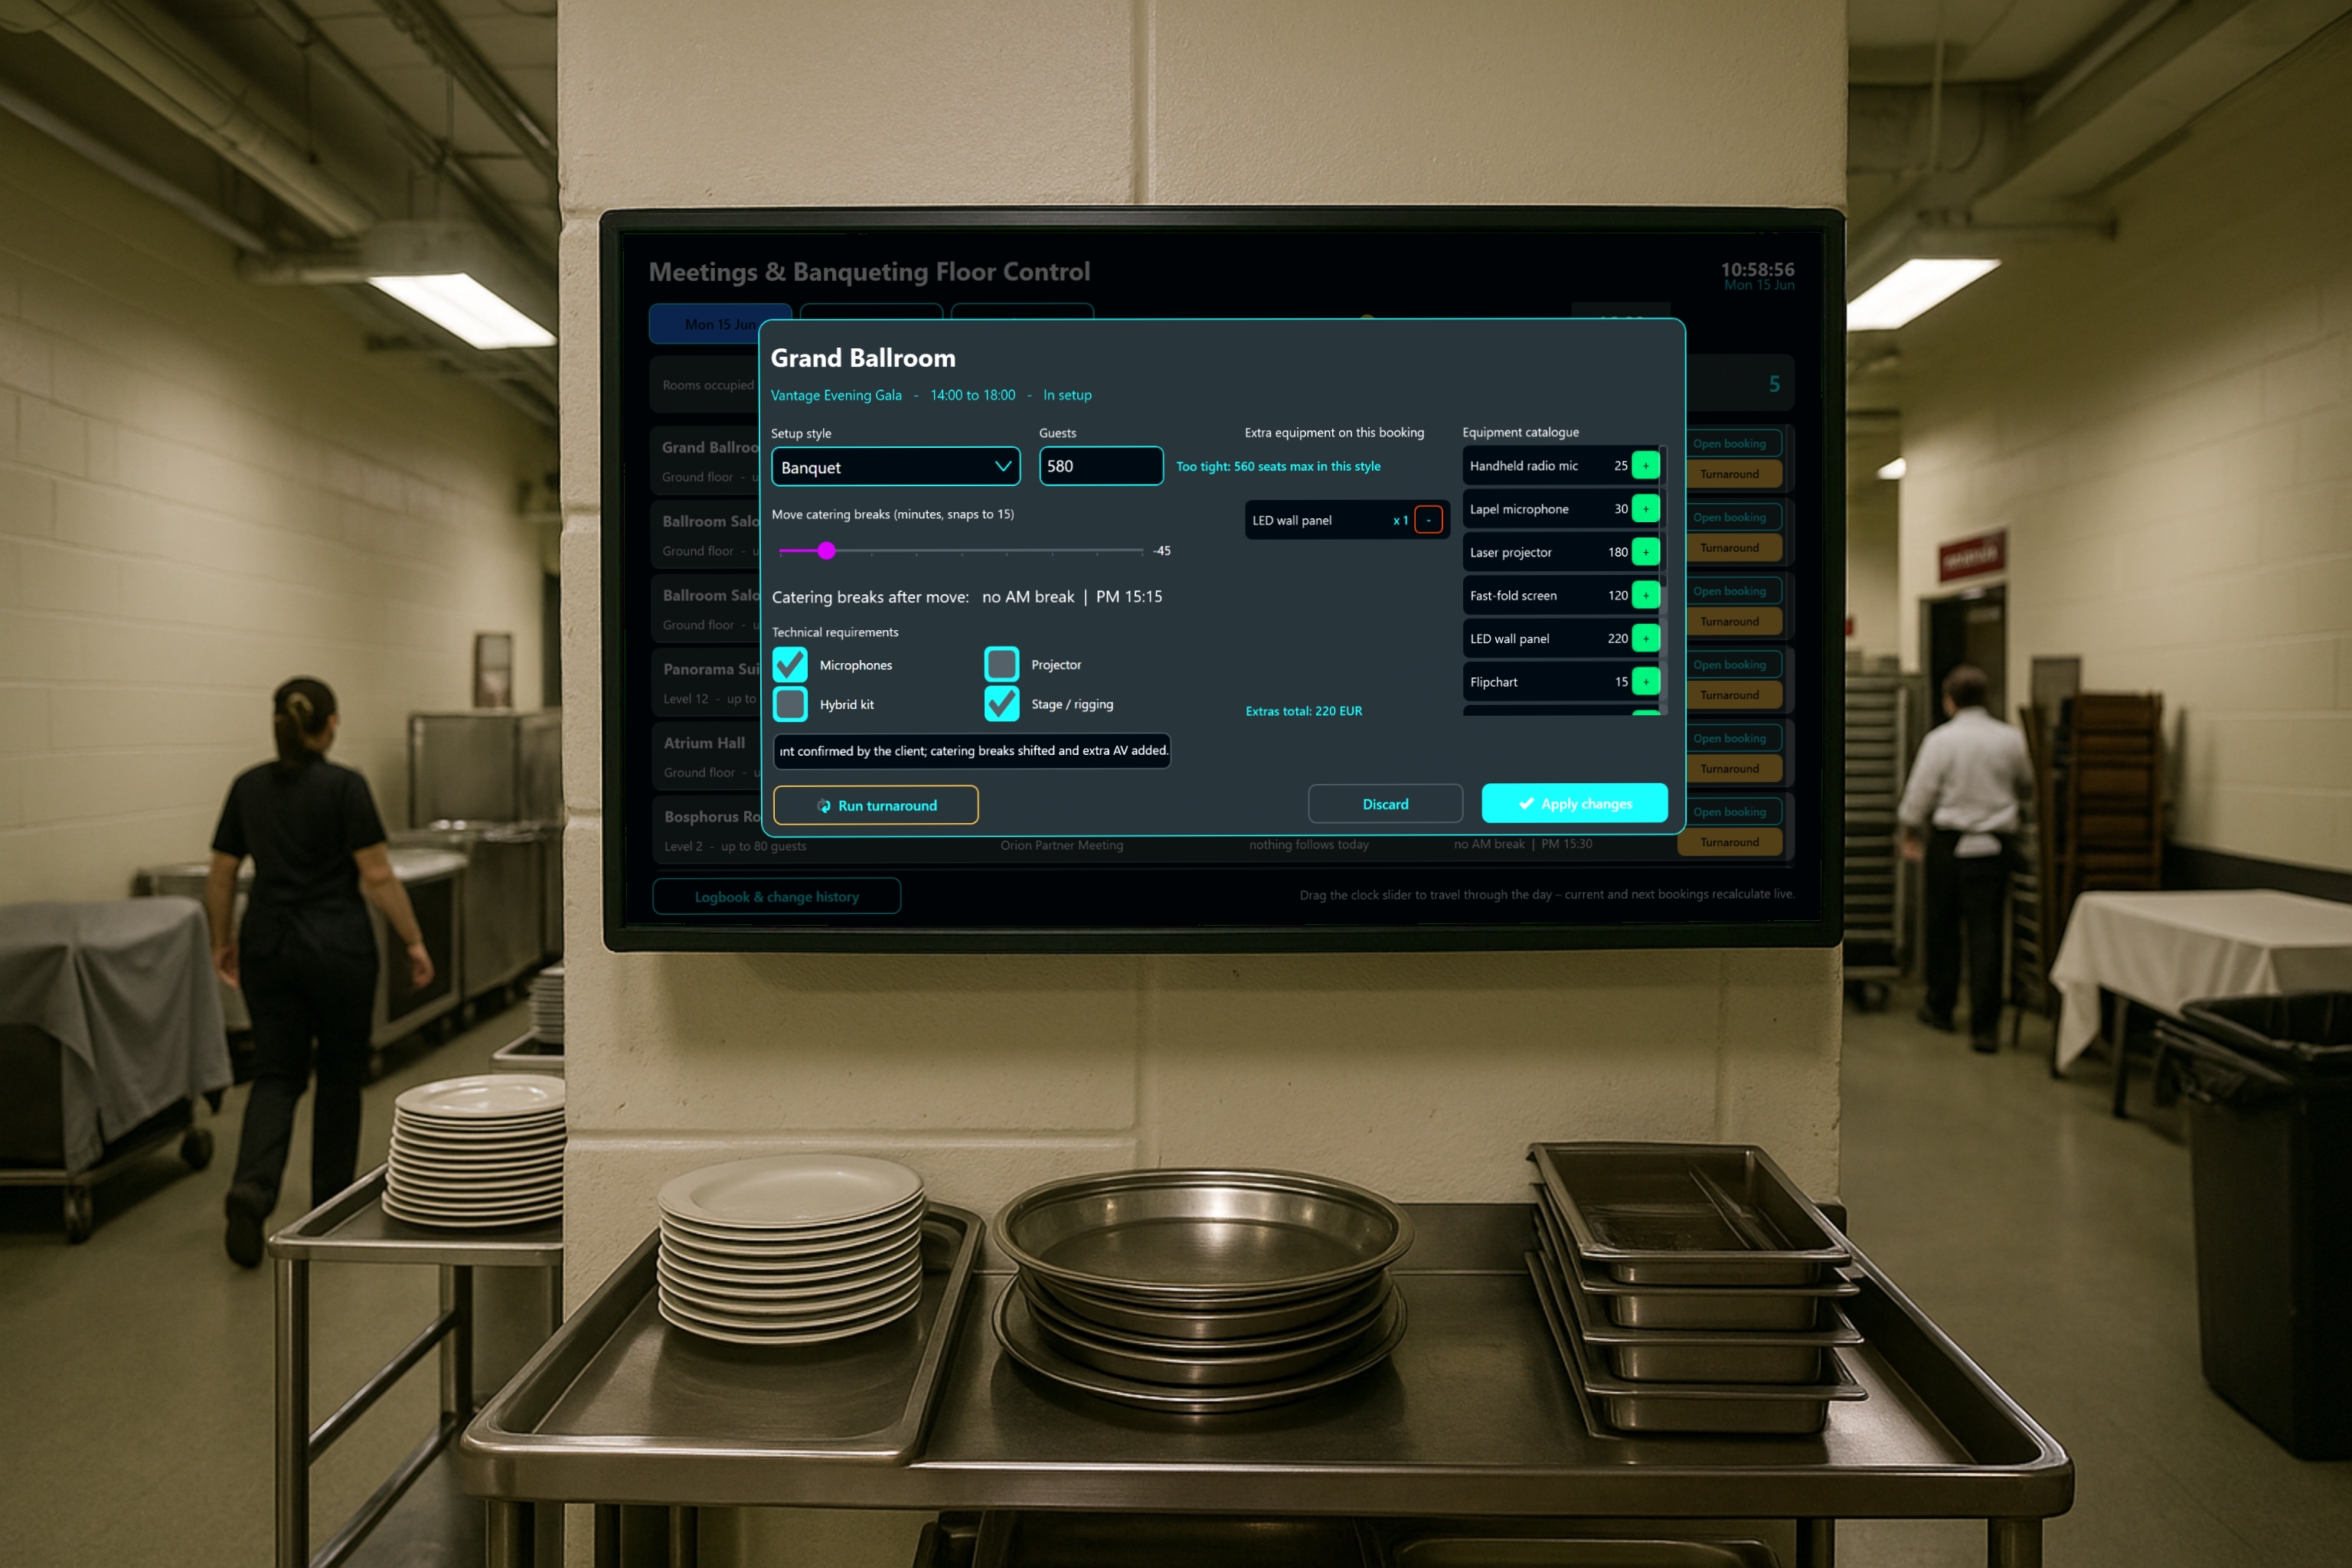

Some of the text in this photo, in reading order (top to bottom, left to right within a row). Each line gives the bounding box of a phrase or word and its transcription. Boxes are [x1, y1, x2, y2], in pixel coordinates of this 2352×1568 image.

[649, 260, 1090, 287] Meetings & Banqueting Floor Control
[1721, 262, 1795, 277] 10:58:56
[685, 318, 756, 330] Mon 15 Jun
[771, 347, 956, 368] Grand Ballroom
[663, 379, 755, 394] Rooms occupied
[1769, 374, 1781, 393] 5
[770, 388, 1093, 404] Vantage Evening Gala 14:00 to 18:00 In setup
[771, 427, 832, 442] Setup style
[1039, 427, 1077, 439] Guests
[1245, 426, 1425, 441] Extra equipment on this booking
[1463, 426, 1579, 441] Equipment catalogue
[662, 440, 758, 454] Grand Ballroo
[1693, 438, 1766, 451] Open booking
[782, 461, 842, 479] Banquet
[1047, 459, 1073, 473] 580
[1176, 460, 1381, 475] Too tight: 560 seats max in this style
[1470, 459, 1579, 472] Handheld radio mic
[1615, 460, 1628, 471] 25
[662, 471, 734, 482] Ground floor
[1700, 469, 1759, 479] Turnaround
[772, 508, 1014, 523] Move catering breaks (minutes, snaps to 15)
[1470, 503, 1570, 518] Lapel microphone
[1615, 503, 1628, 514] 30
[1253, 514, 1332, 529] LED wall panel
[1403, 514, 1408, 525] 1
[1152, 545, 1171, 556] -45
[1471, 546, 1553, 561] Laser projector
[1609, 547, 1628, 557] 180
[772, 589, 1162, 608] Catering breaks after move: no AM break PM 15:15
[1471, 590, 1557, 601] Fast-fold screen
[1609, 590, 1628, 601] 120
[772, 626, 900, 641] Technical requirements
[1471, 632, 1550, 647] LED wall panel
[1608, 633, 1629, 644] 220
[820, 659, 893, 674] Microphones
[1031, 658, 1083, 674] Projector
[1471, 676, 1518, 691] Flipchart
[1615, 676, 1628, 688] 15
[820, 698, 875, 713] Hybrid kit
[1031, 698, 1114, 713] Stage rigging
[1246, 705, 1363, 717] Extras total: 220 EUR
[663, 736, 746, 750] Atrium Hall
[797, 745, 854, 756] confirmed
[857, 745, 871, 760] by
[873, 745, 892, 756] the
[894, 745, 927, 758] client;
[930, 745, 975, 760] catering
[978, 744, 1015, 756] breaks
[1018, 744, 1055, 756] shifted
[1058, 744, 1080, 756] and
[1083, 746, 1110, 756] extra
[1112, 745, 1129, 756] AV
[1131, 744, 1169, 756] added.
[838, 799, 938, 812] Run turnaround
[1363, 797, 1410, 810] Discard
[1541, 797, 1633, 813] Apply changes
[665, 840, 807, 854] Level 2 up to 80 guests
[1001, 839, 1124, 854] Orion Partner Meeting
[695, 890, 860, 906] Logbook & change history
[1300, 887, 1795, 903] Drag the clock slider to travel through the day current and next bookings recalculate live.
